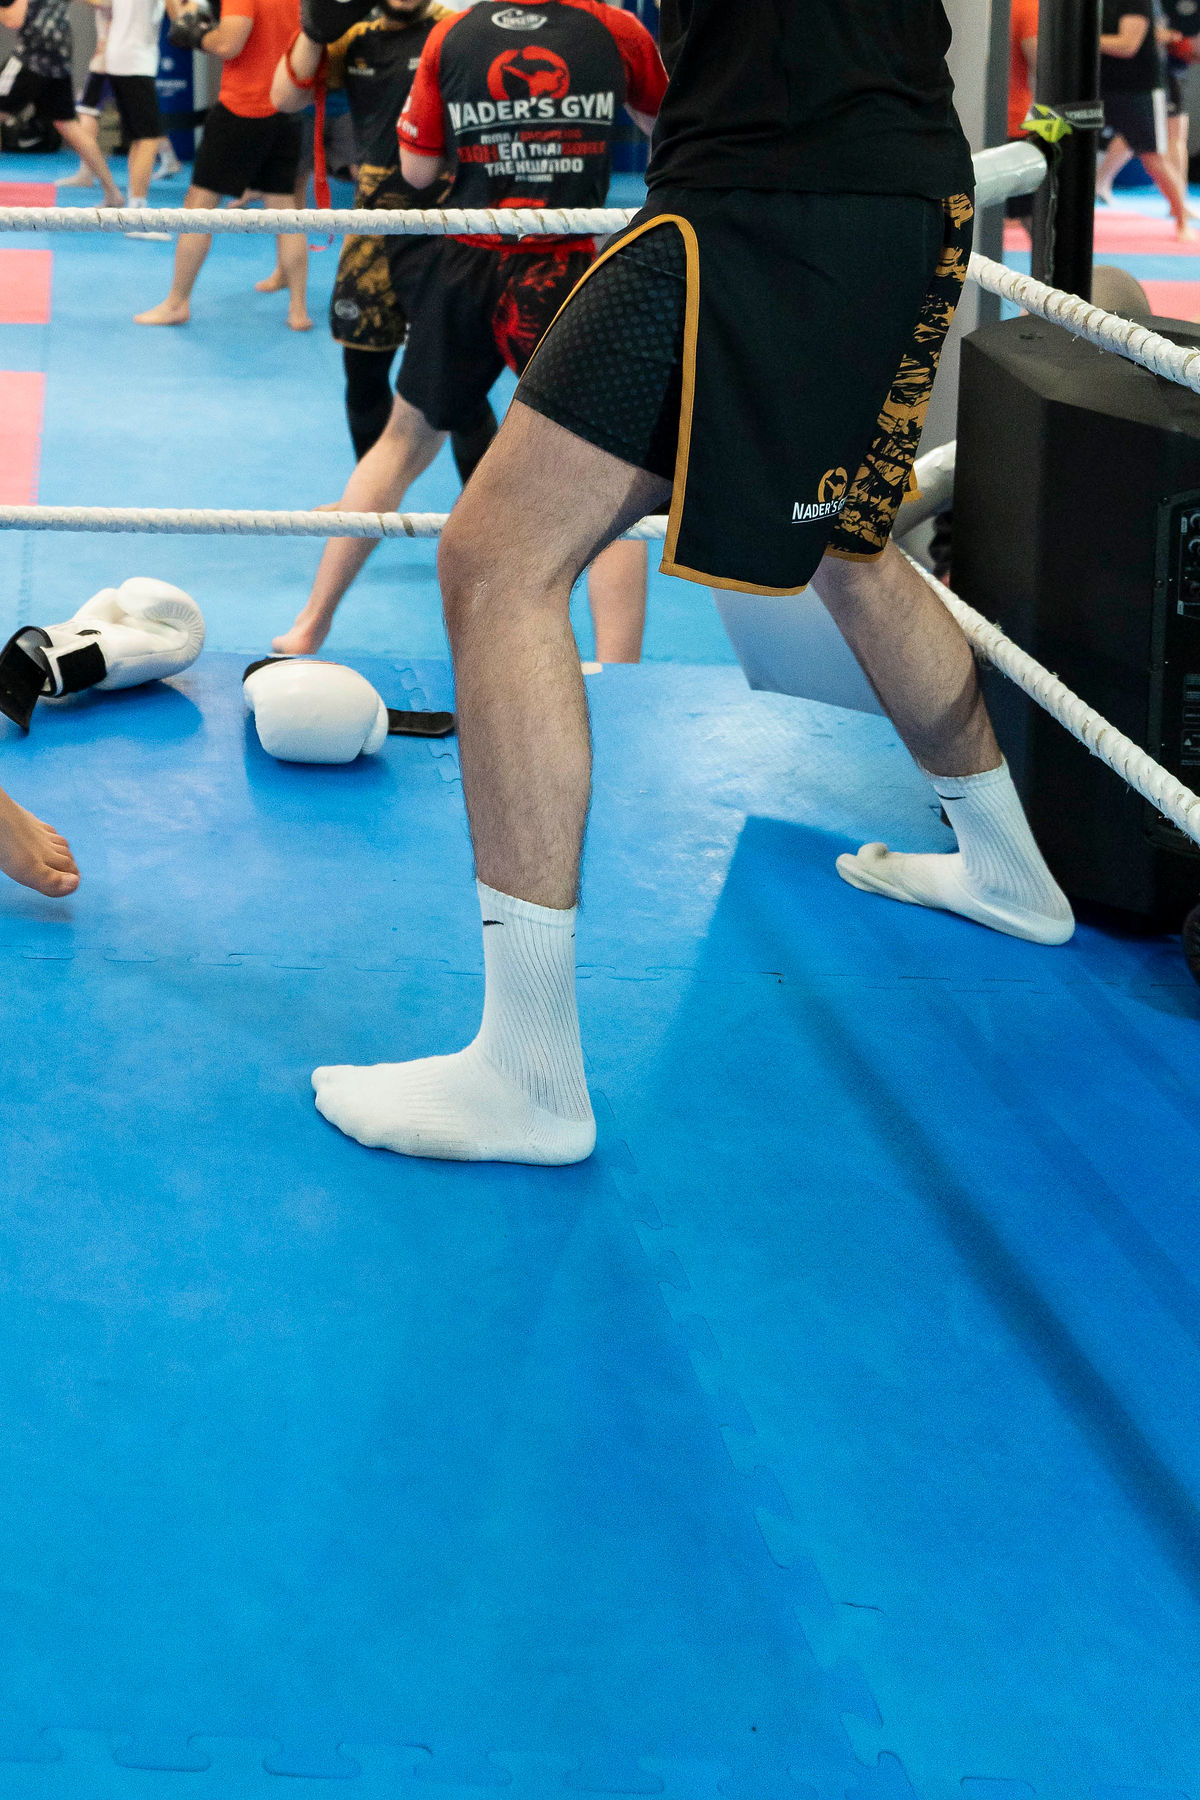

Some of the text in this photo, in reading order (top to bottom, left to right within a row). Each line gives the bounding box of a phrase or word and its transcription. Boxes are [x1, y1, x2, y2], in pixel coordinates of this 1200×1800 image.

[448, 96, 555, 130] NADER'S
[560, 91, 615, 119] GYM
[792, 501, 838, 520] NADER'S
